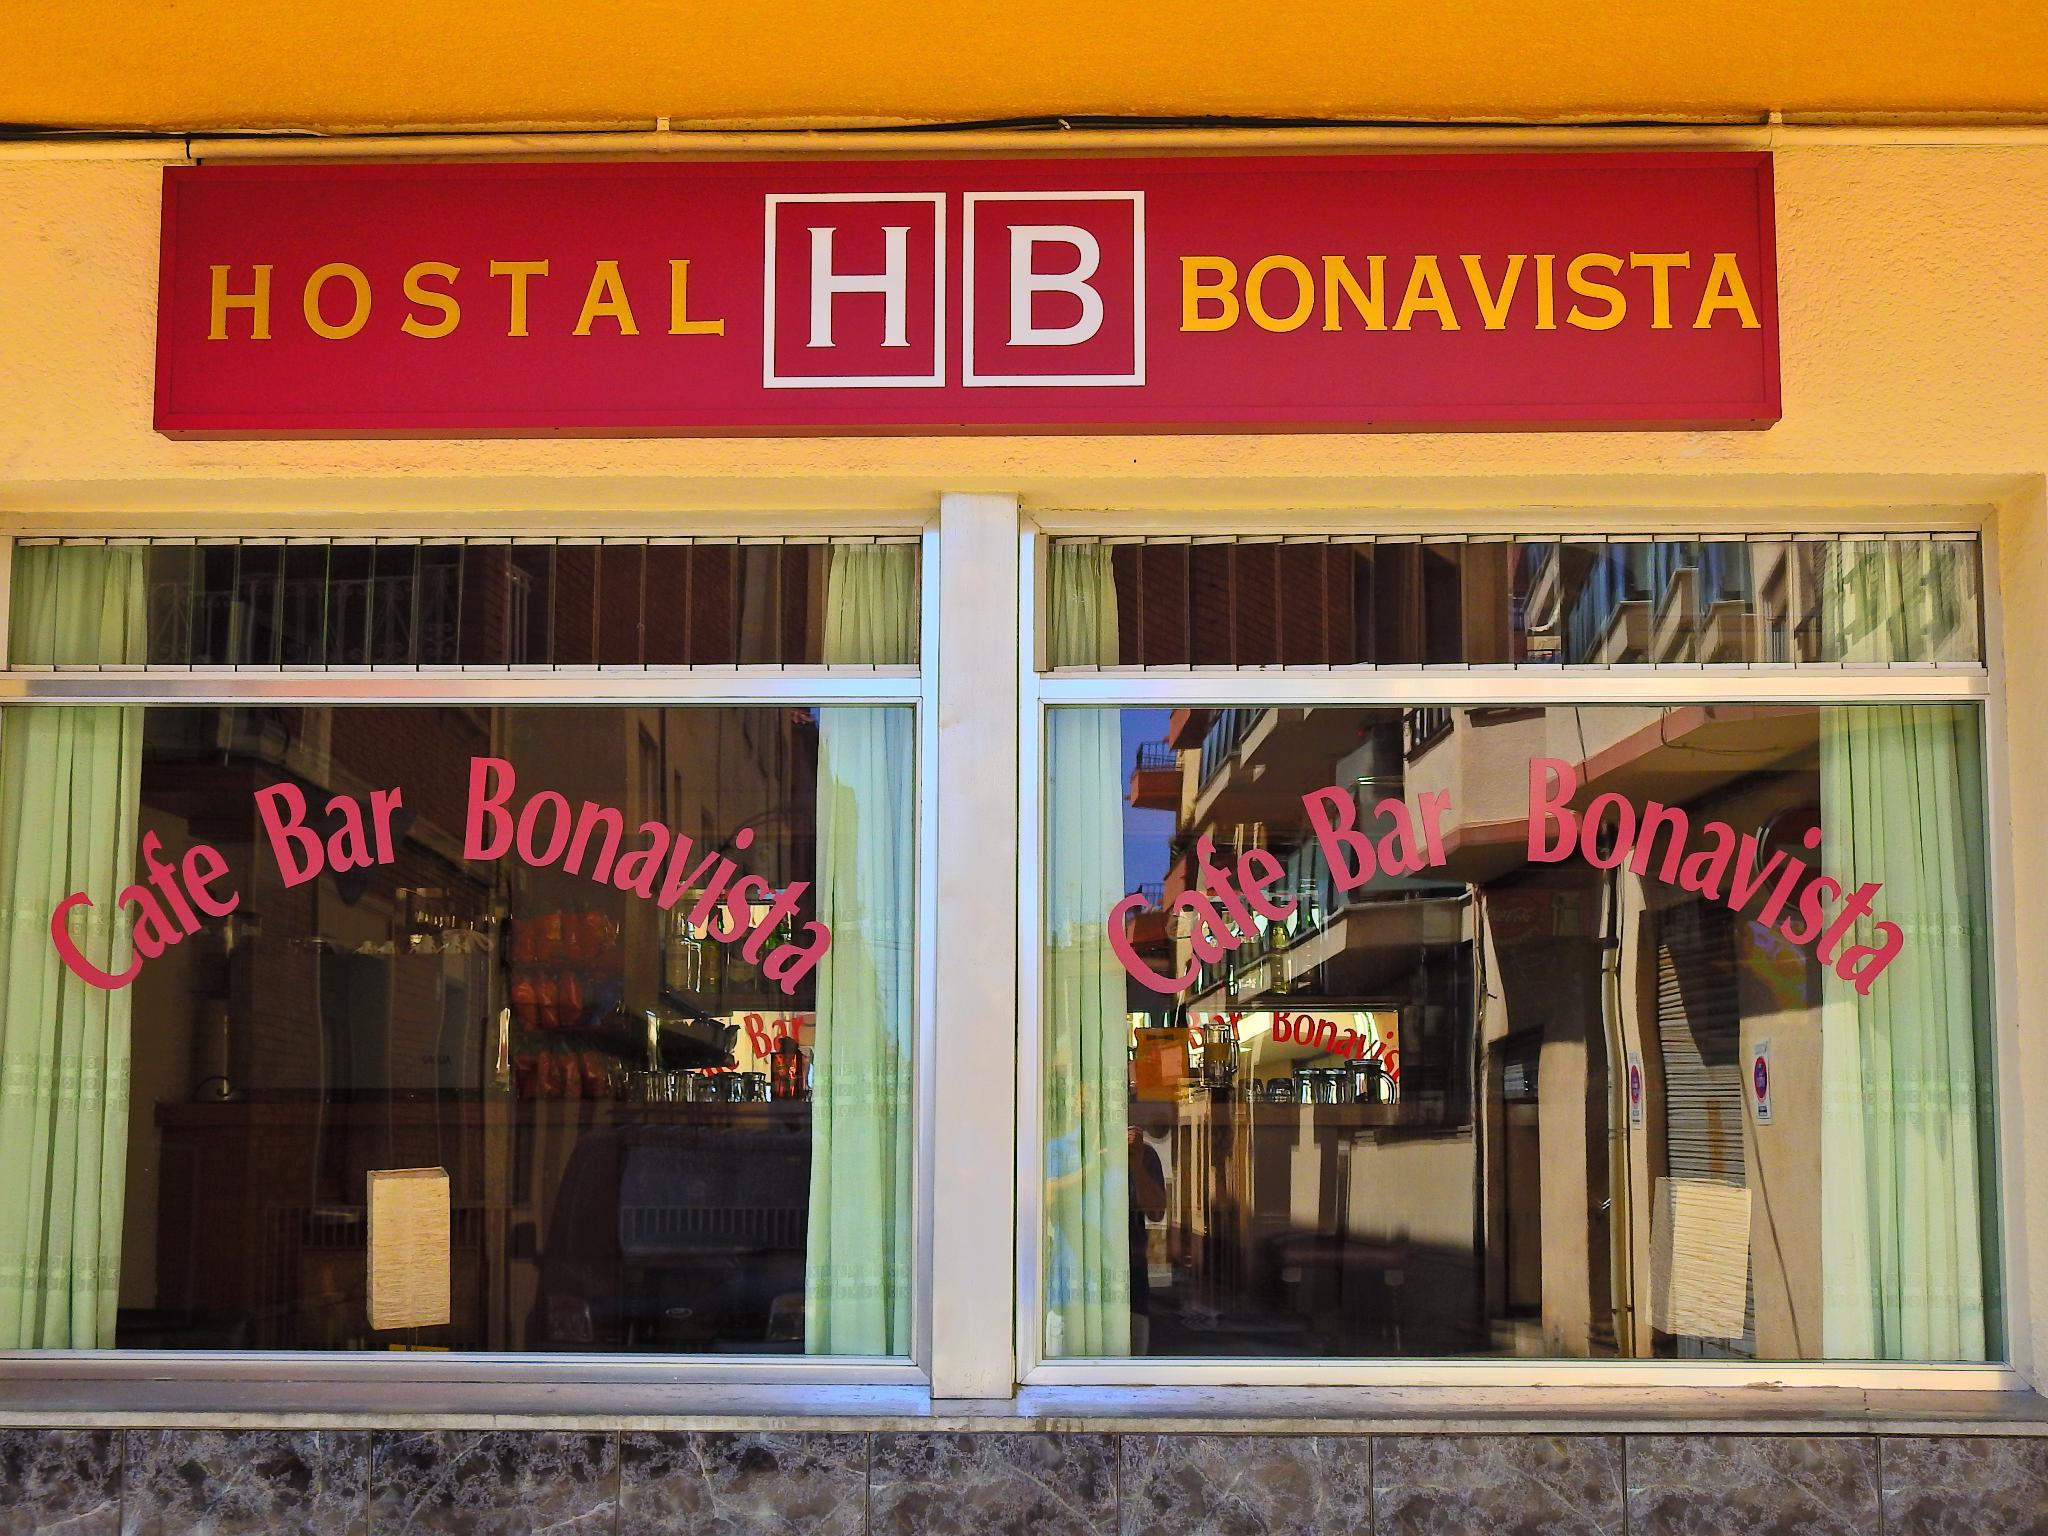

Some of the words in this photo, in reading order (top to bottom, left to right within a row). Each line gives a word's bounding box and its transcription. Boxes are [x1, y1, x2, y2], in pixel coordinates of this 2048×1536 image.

[207, 259, 726, 340] HOSTAL
[1179, 251, 1762, 333] BONAVISTA
[51, 830, 240, 990] Cafe
[254, 782, 403, 889] Bar
[463, 756, 832, 996] Bonavista
[1107, 834, 1298, 994] Cafe
[1302, 785, 1453, 893] Bar
[1527, 757, 1904, 996] Bonavista
[744, 1013, 804, 1060] Bar
